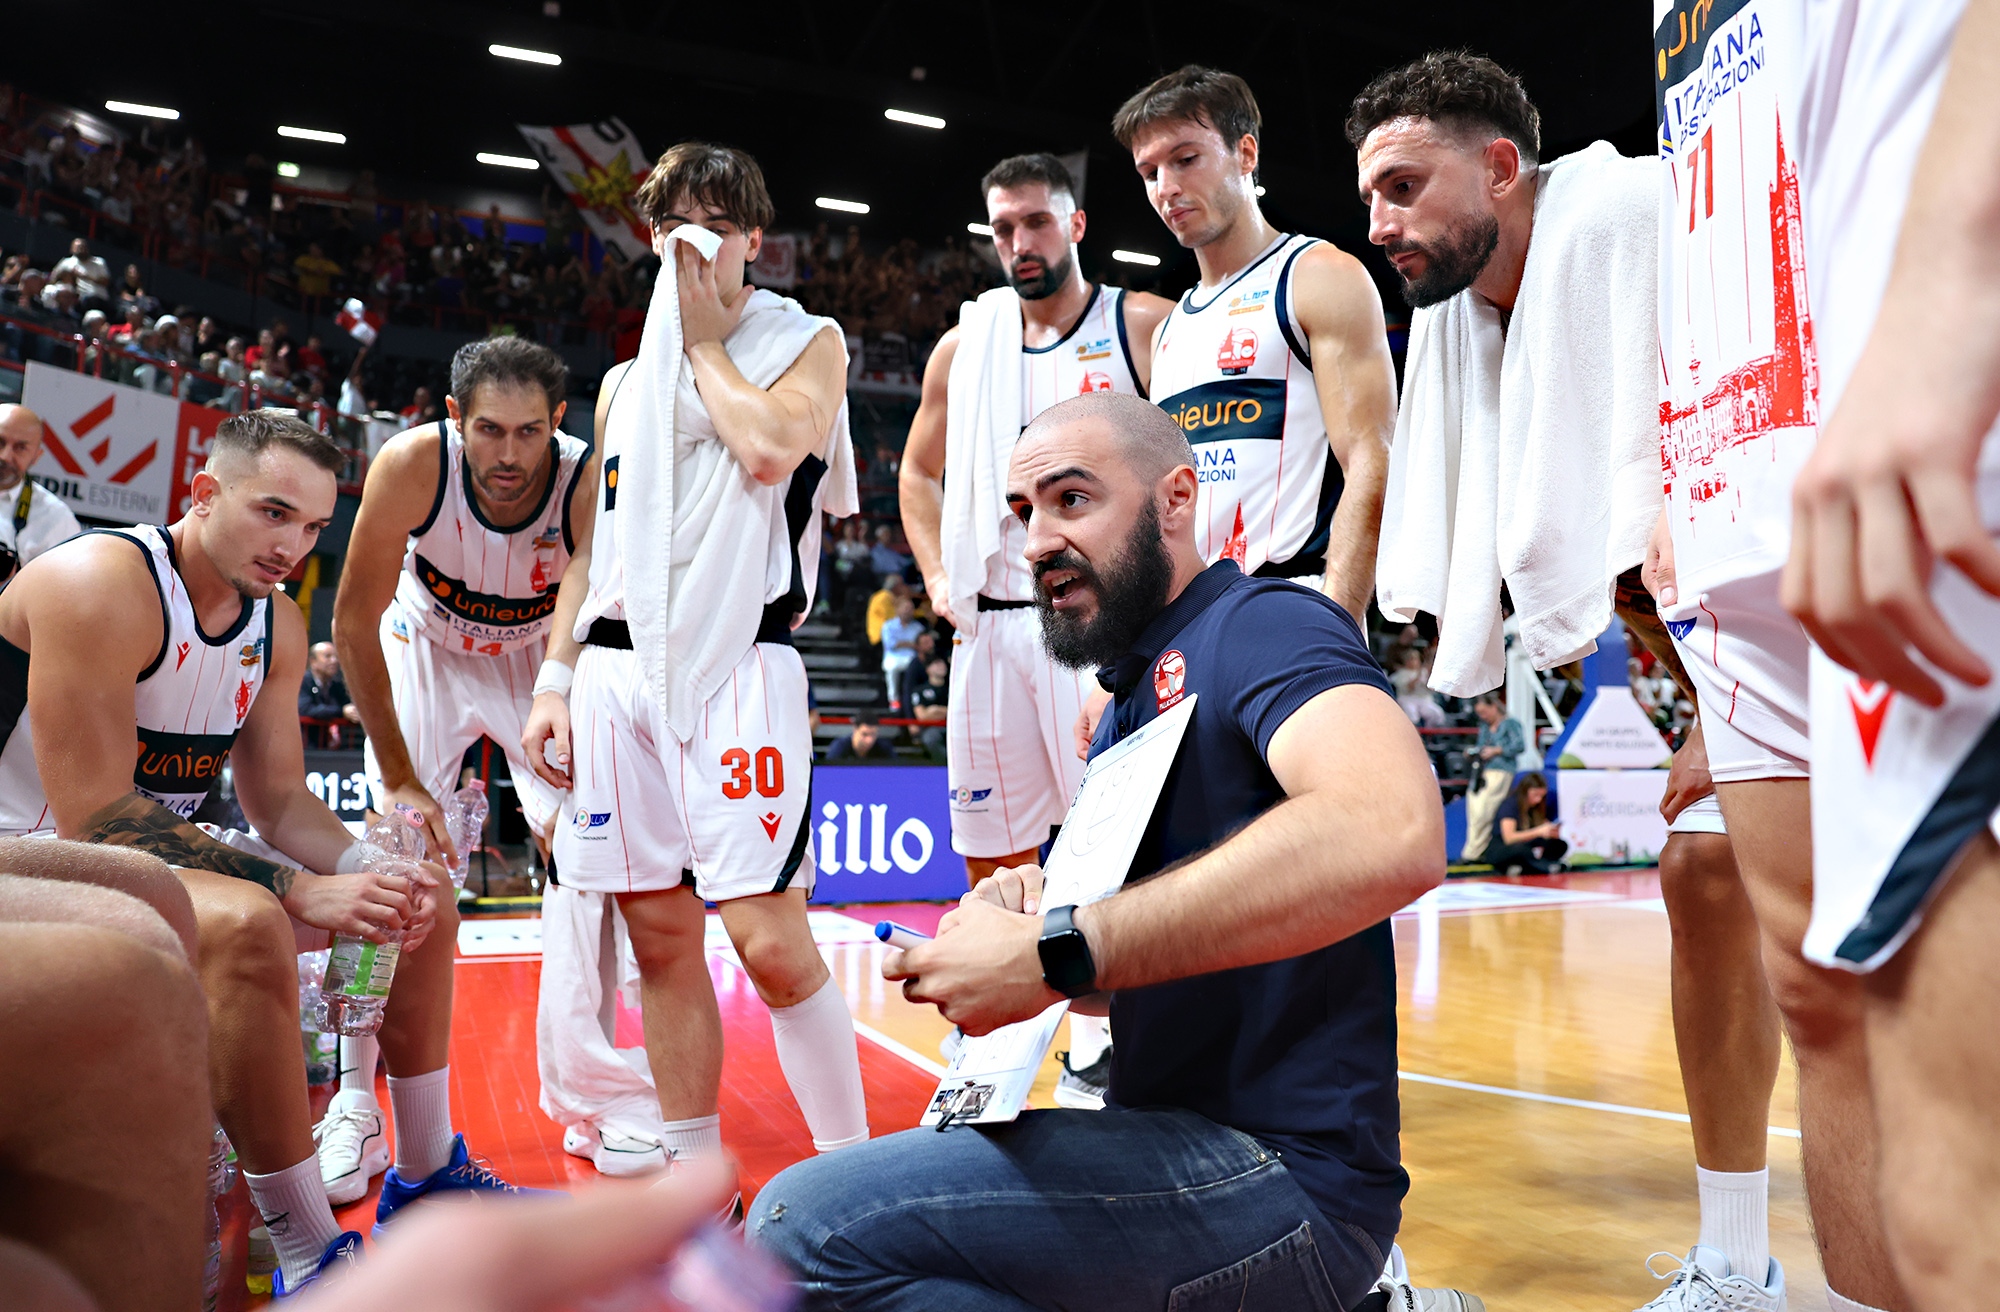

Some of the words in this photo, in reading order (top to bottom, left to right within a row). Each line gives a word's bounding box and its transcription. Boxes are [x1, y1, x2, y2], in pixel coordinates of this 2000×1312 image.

[454, 593, 557, 621] unieuro
[720, 746, 785, 800] 30
[813, 801, 934, 876] illo
